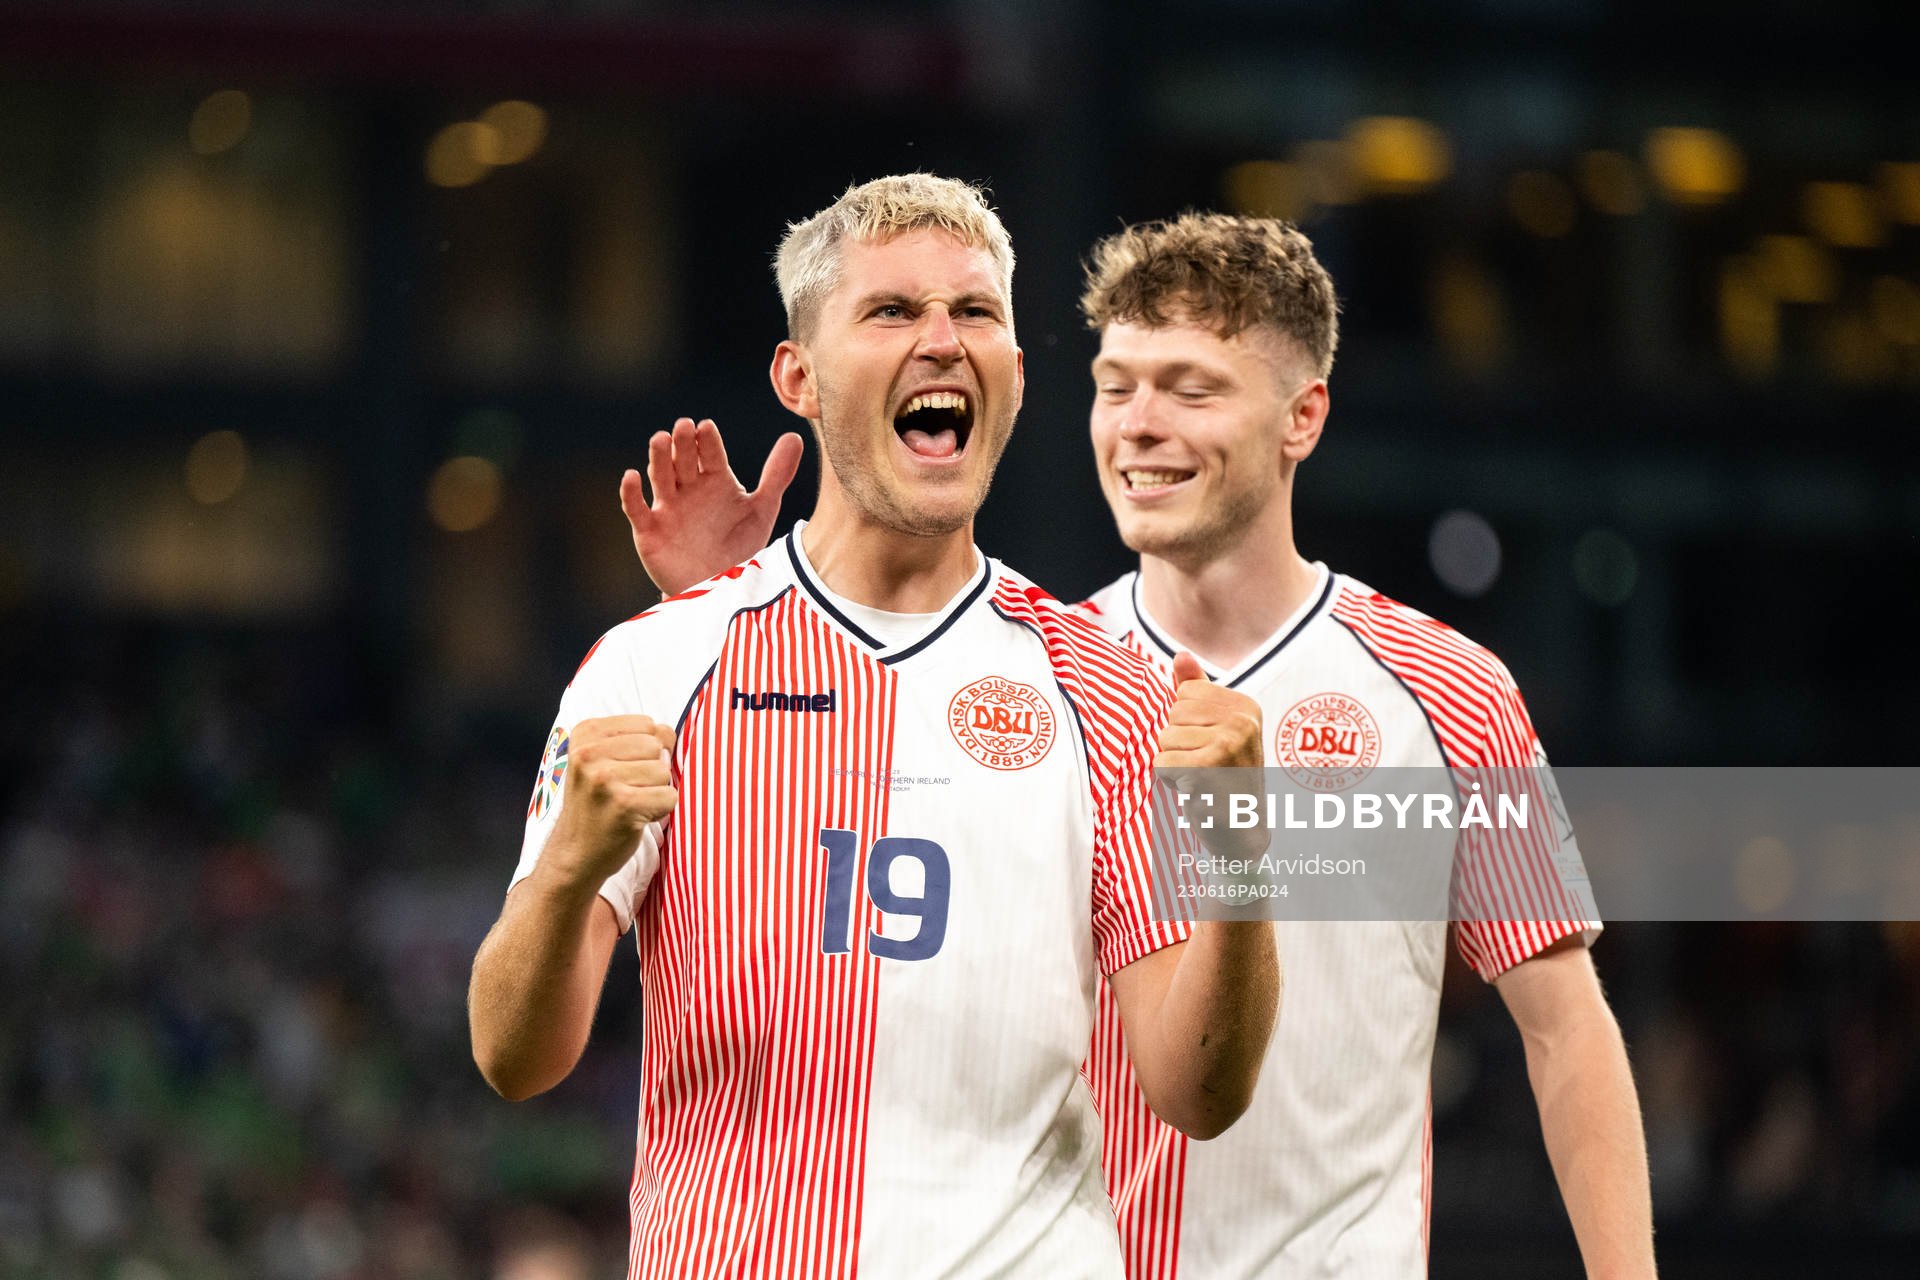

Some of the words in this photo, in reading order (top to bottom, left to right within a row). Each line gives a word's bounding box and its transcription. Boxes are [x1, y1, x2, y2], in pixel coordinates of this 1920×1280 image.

[732, 687, 836, 712] hummel
[953, 698, 978, 751] DANSK
[972, 705, 1033, 735] DBU
[1280, 719, 1300, 775] DANSK
[1298, 726, 1358, 756] DBU
[981, 751, 1024, 767] 1889
[916, 777, 950, 785] IRELAND
[1305, 777, 1345, 789] 1889
[819, 829, 951, 962] 19
